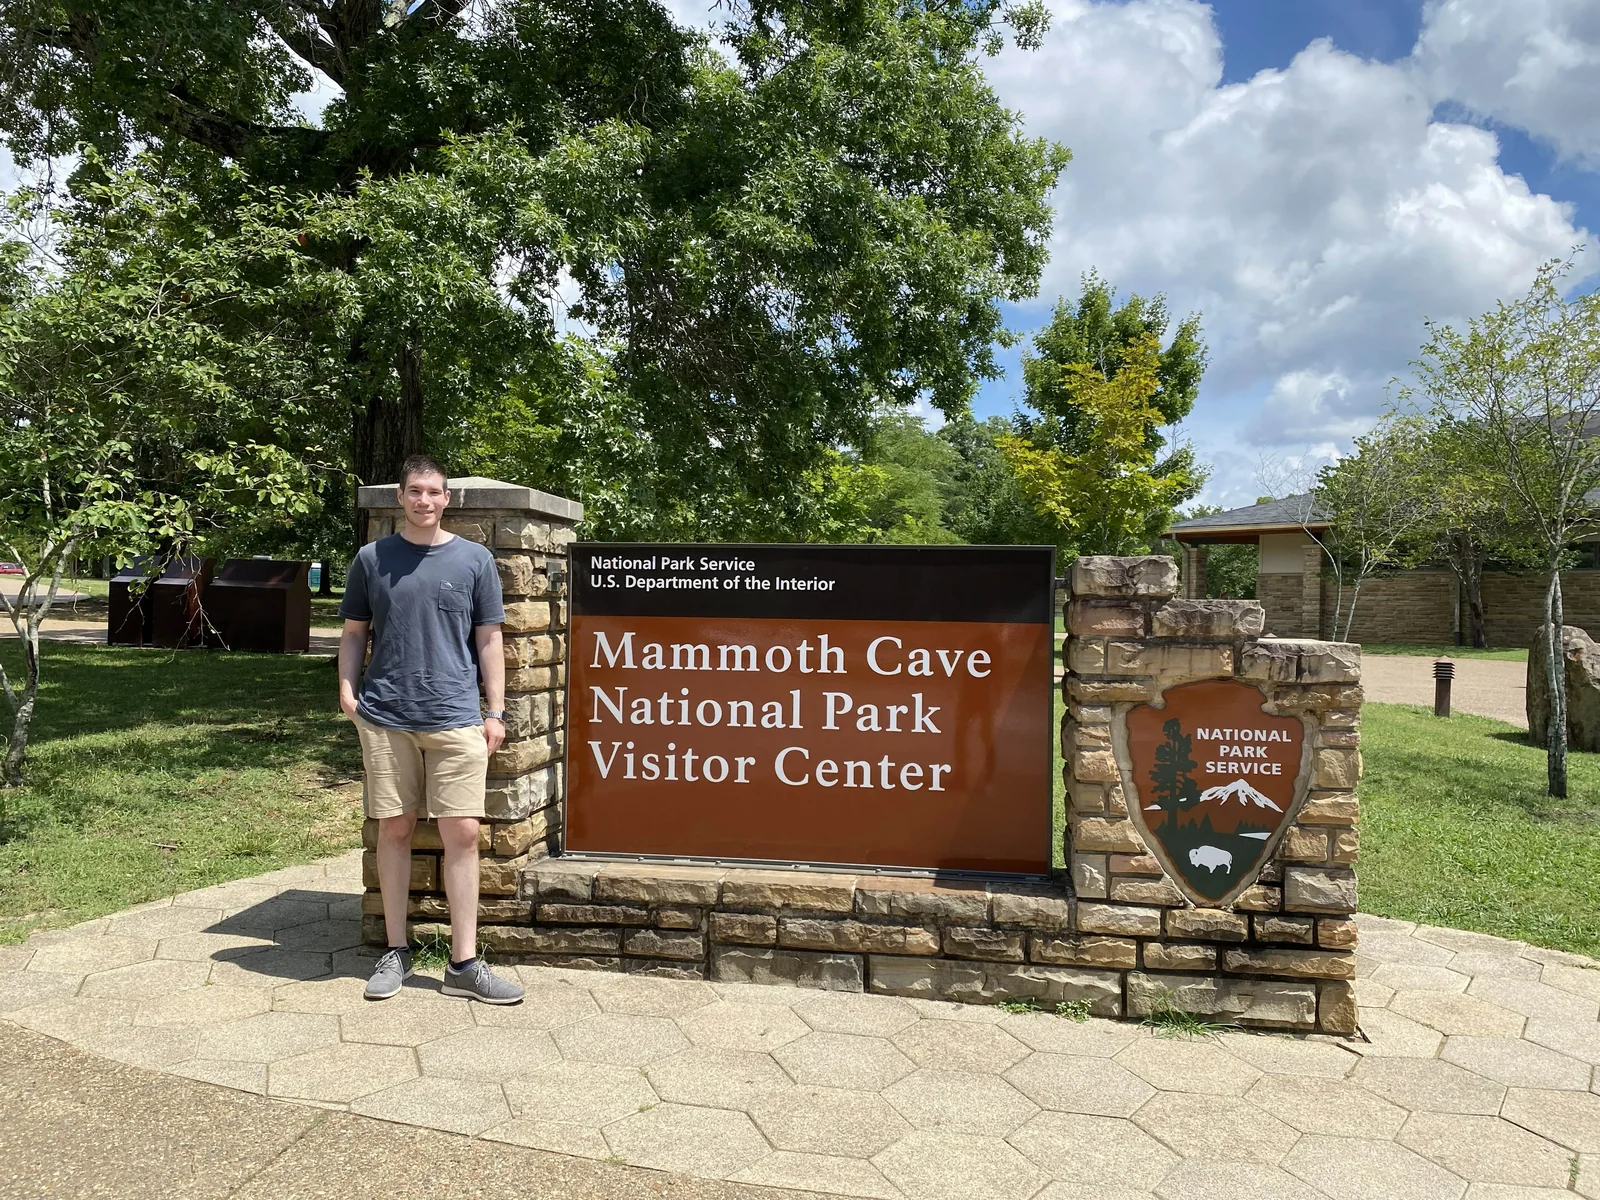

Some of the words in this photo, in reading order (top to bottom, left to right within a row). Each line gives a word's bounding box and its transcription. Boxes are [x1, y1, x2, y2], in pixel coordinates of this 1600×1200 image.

[591, 555, 656, 570] National
[661, 556, 695, 571] Park
[699, 556, 756, 571] Service
[590, 574, 620, 588] U.S.
[625, 574, 719, 592] Department
[723, 575, 741, 590] of
[744, 575, 771, 591] the
[775, 576, 836, 591] Interior
[589, 631, 848, 674] Mammoth
[866, 635, 992, 678] Cave
[588, 685, 804, 729] National
[821, 691, 942, 734] Park
[1196, 727, 1292, 743] NATIONAL
[1219, 744, 1268, 759] PARK
[587, 740, 756, 784] Visitor
[774, 746, 952, 792] Center
[1205, 760, 1282, 775] SERVICE
